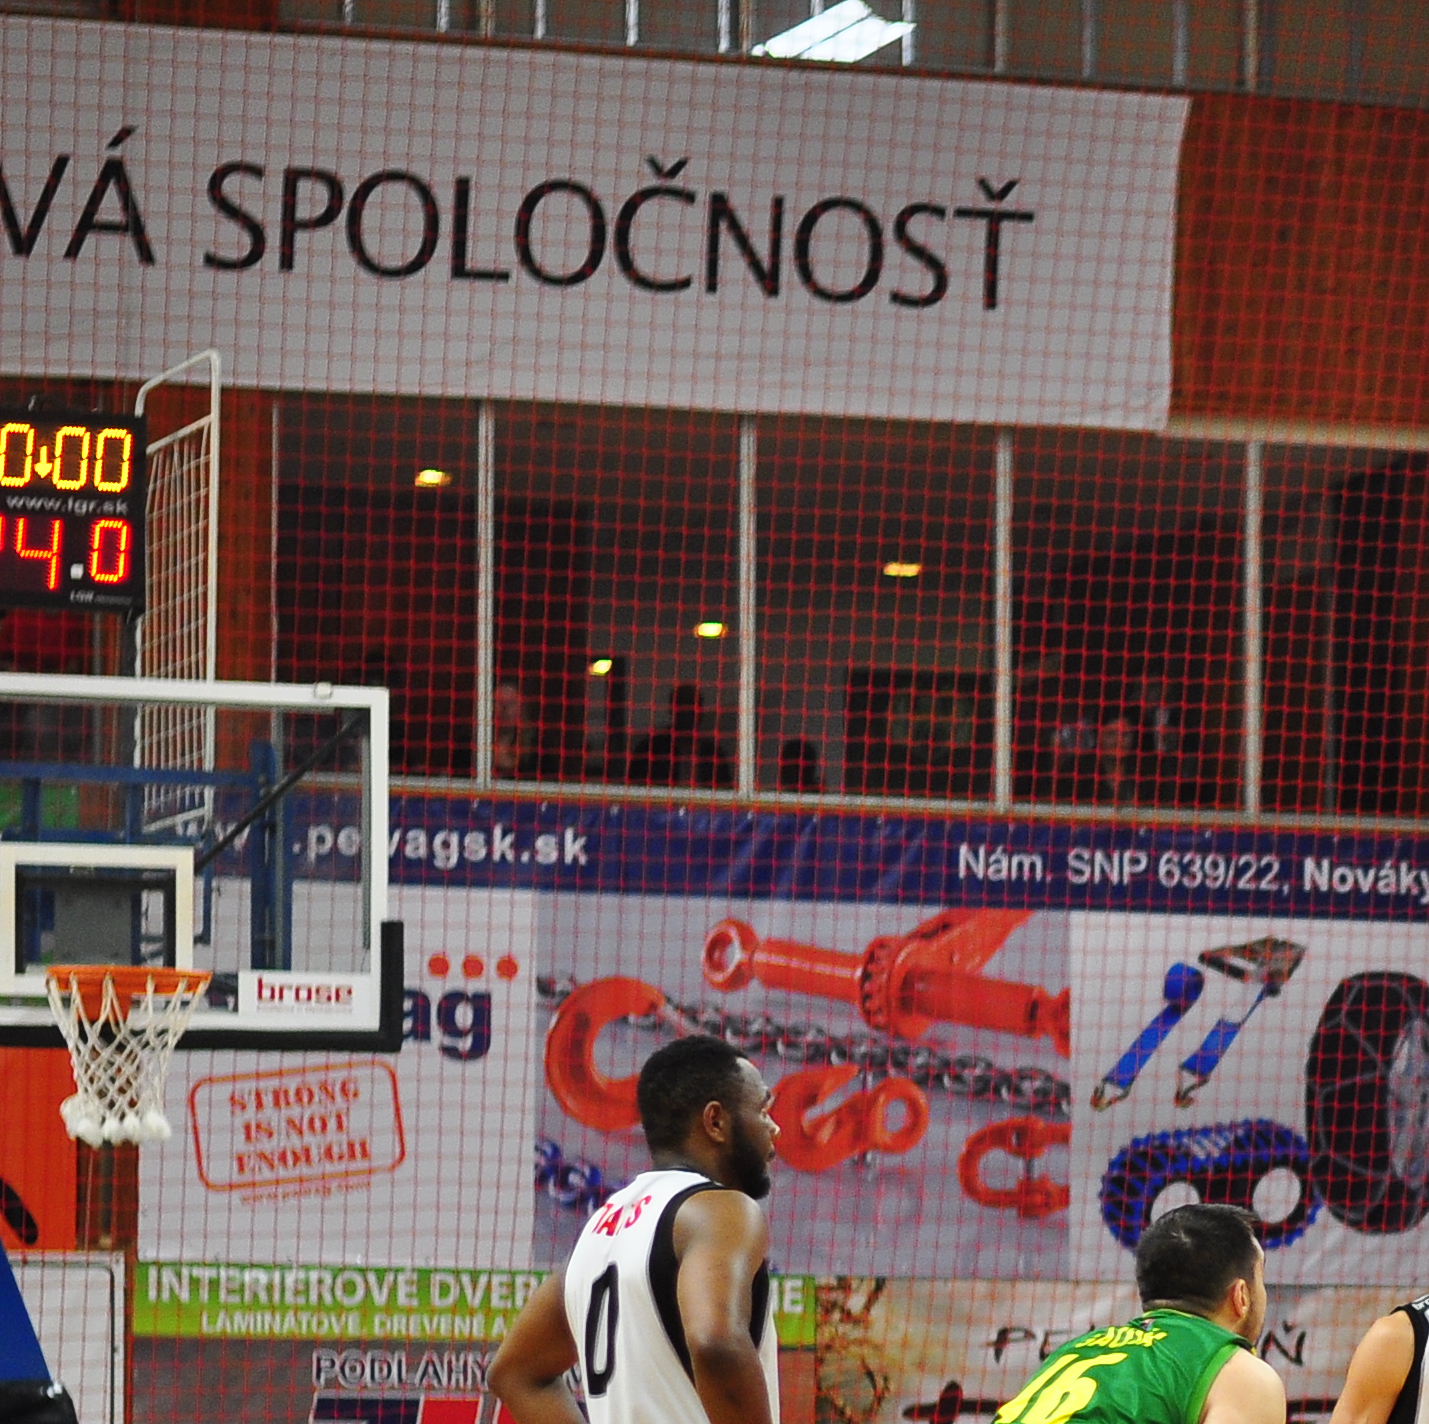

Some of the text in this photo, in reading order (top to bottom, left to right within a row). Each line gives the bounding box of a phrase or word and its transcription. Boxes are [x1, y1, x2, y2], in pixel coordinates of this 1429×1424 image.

[203, 154, 1035, 312] SPOLOČNOSŤ
[959, 843, 1052, 884] Nám.
[1068, 852, 1149, 885] SNP
[1158, 853, 1290, 894] 639/22,
[584, 1261, 620, 1398] 0
